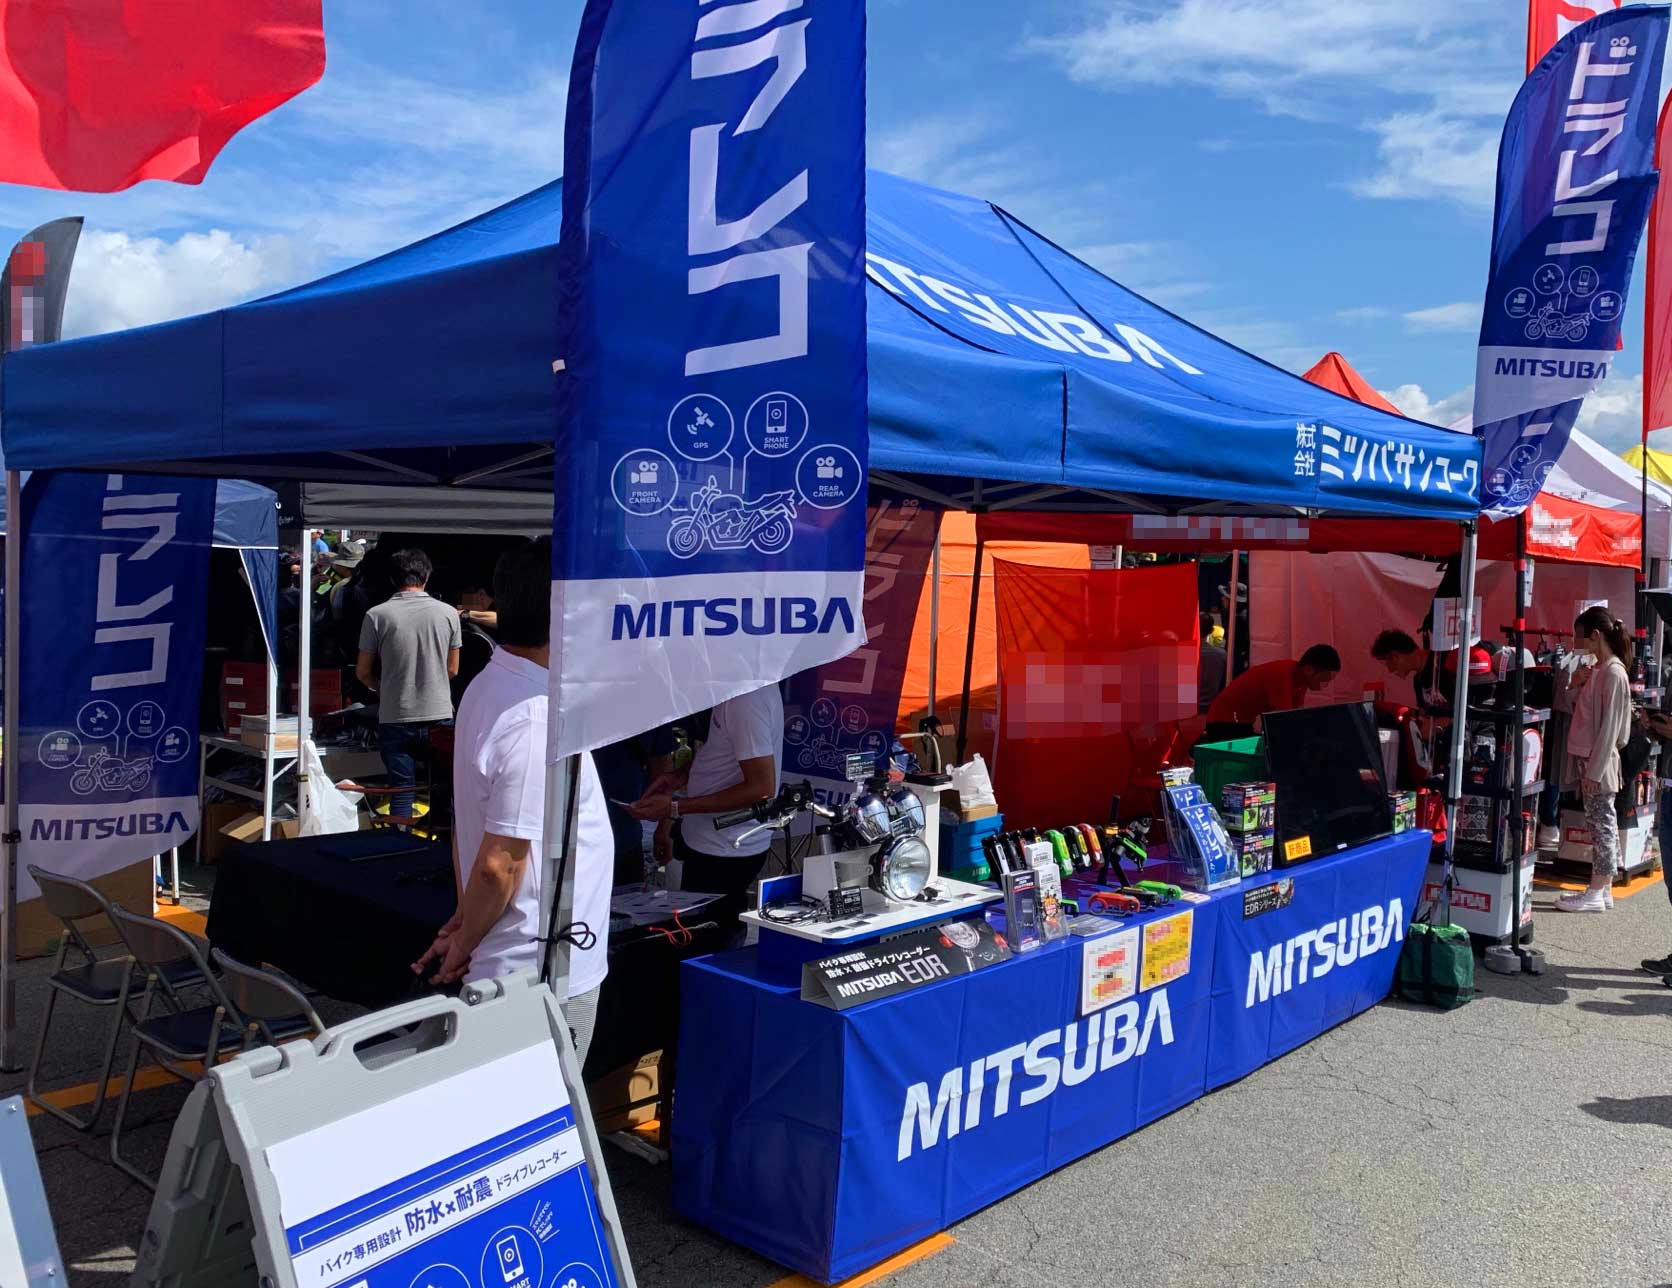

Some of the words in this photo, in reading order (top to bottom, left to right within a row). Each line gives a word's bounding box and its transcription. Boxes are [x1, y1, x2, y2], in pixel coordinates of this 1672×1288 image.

[685, 0, 816, 376] ラレコ
[1495, 358, 1607, 379] MITSUBA
[763, 442, 789, 450] PHONE
[1321, 425, 1478, 496] ミツバサンコーワ
[632, 490, 658, 498] FRONT
[812, 490, 844, 498] CAMERA
[611, 597, 855, 641] MITSUBA
[30, 811, 190, 840] MITSUBA
[1246, 898, 1403, 1008] MITSUBA
[837, 971, 904, 997] MITSUBA
[898, 954, 950, 984] EDR
[898, 988, 1174, 1162] MITSUBA
[320, 1226, 402, 1277] バイク専用設計
